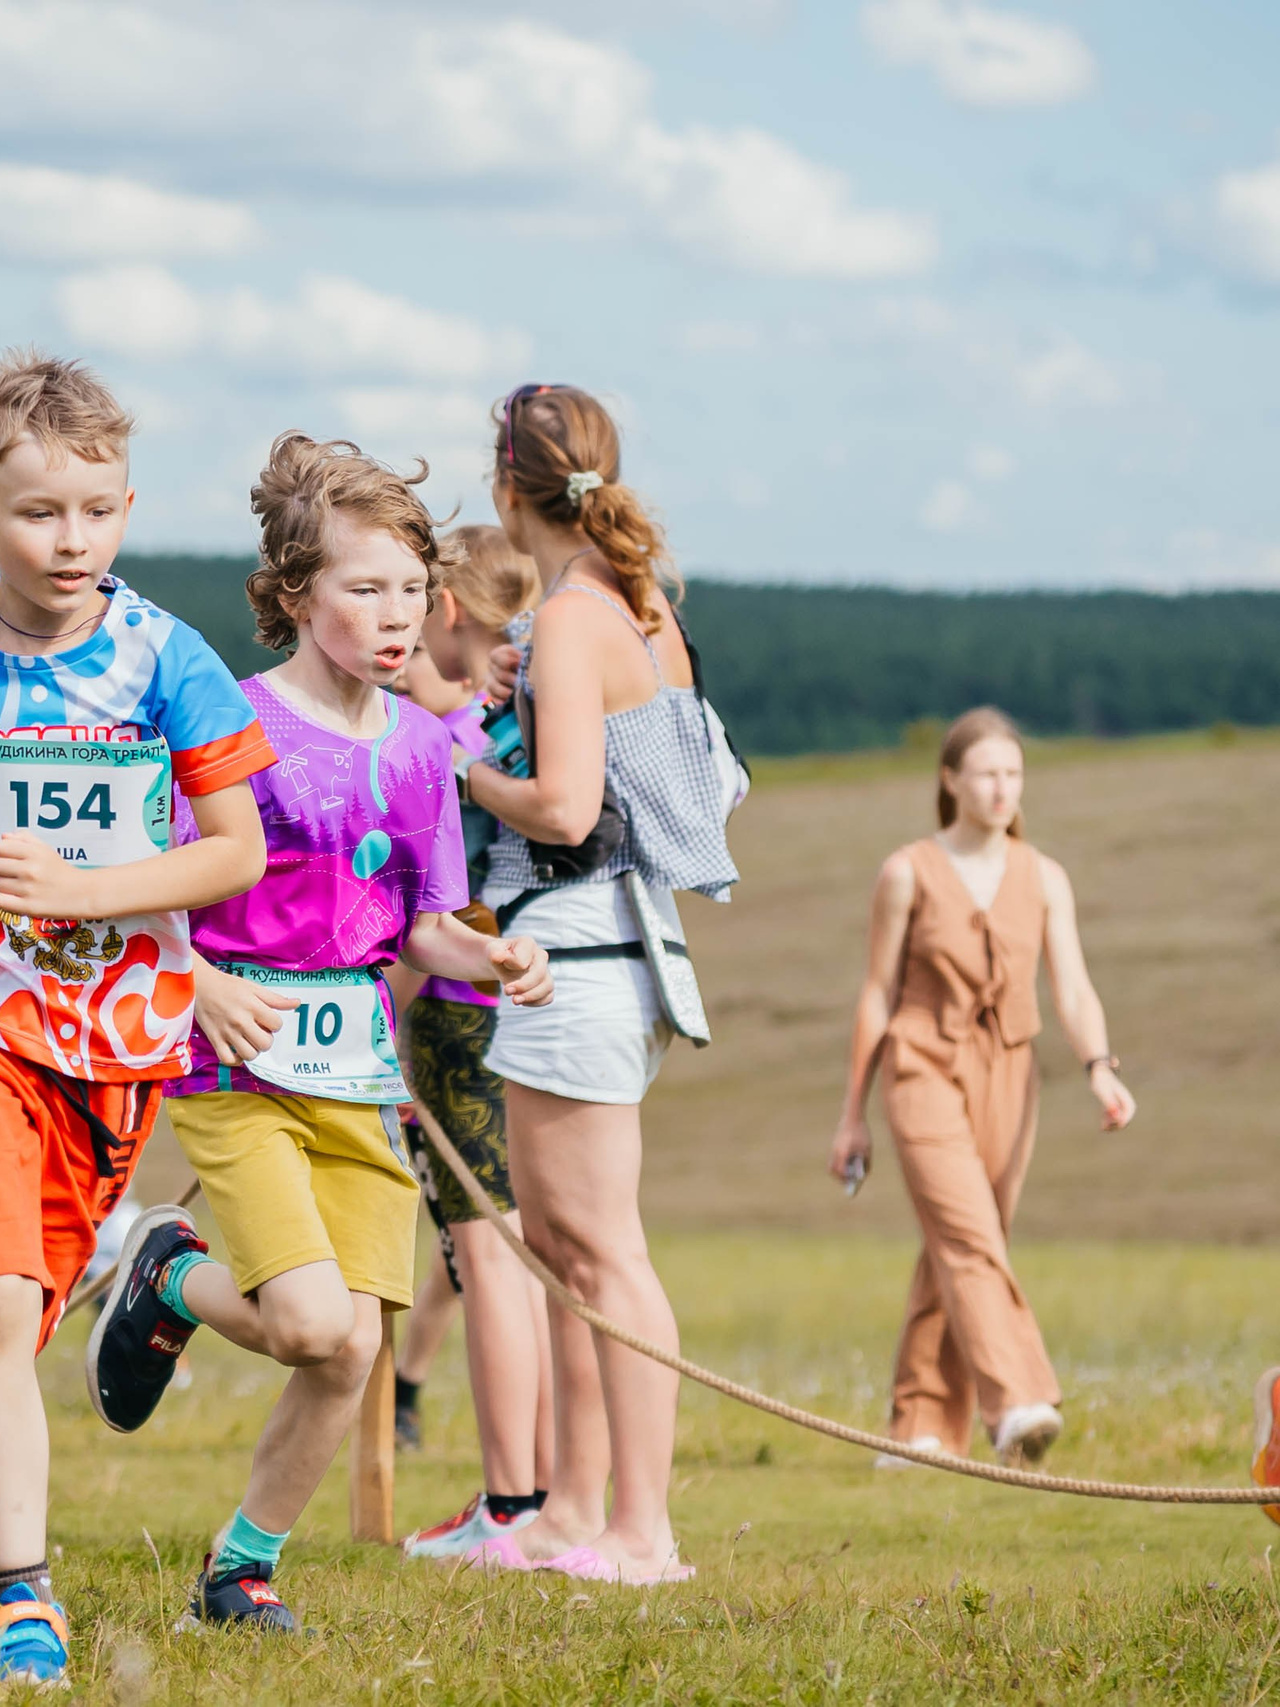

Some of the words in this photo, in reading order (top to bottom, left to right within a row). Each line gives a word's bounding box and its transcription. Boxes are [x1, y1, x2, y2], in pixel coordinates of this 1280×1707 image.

[72, 747, 109, 762] ГОРА
[112, 745, 161, 764] ТРЕЙЛ
[10, 780, 117, 830] 154
[151, 817, 165, 827] 1
[56, 847, 88, 861] ША
[250, 969, 325, 983] КУДЫКИНА
[293, 1002, 343, 1047] 10
[376, 1037, 387, 1045] 1
[293, 1062, 331, 1075] ИВАН
[151, 1335, 182, 1353] FILA
